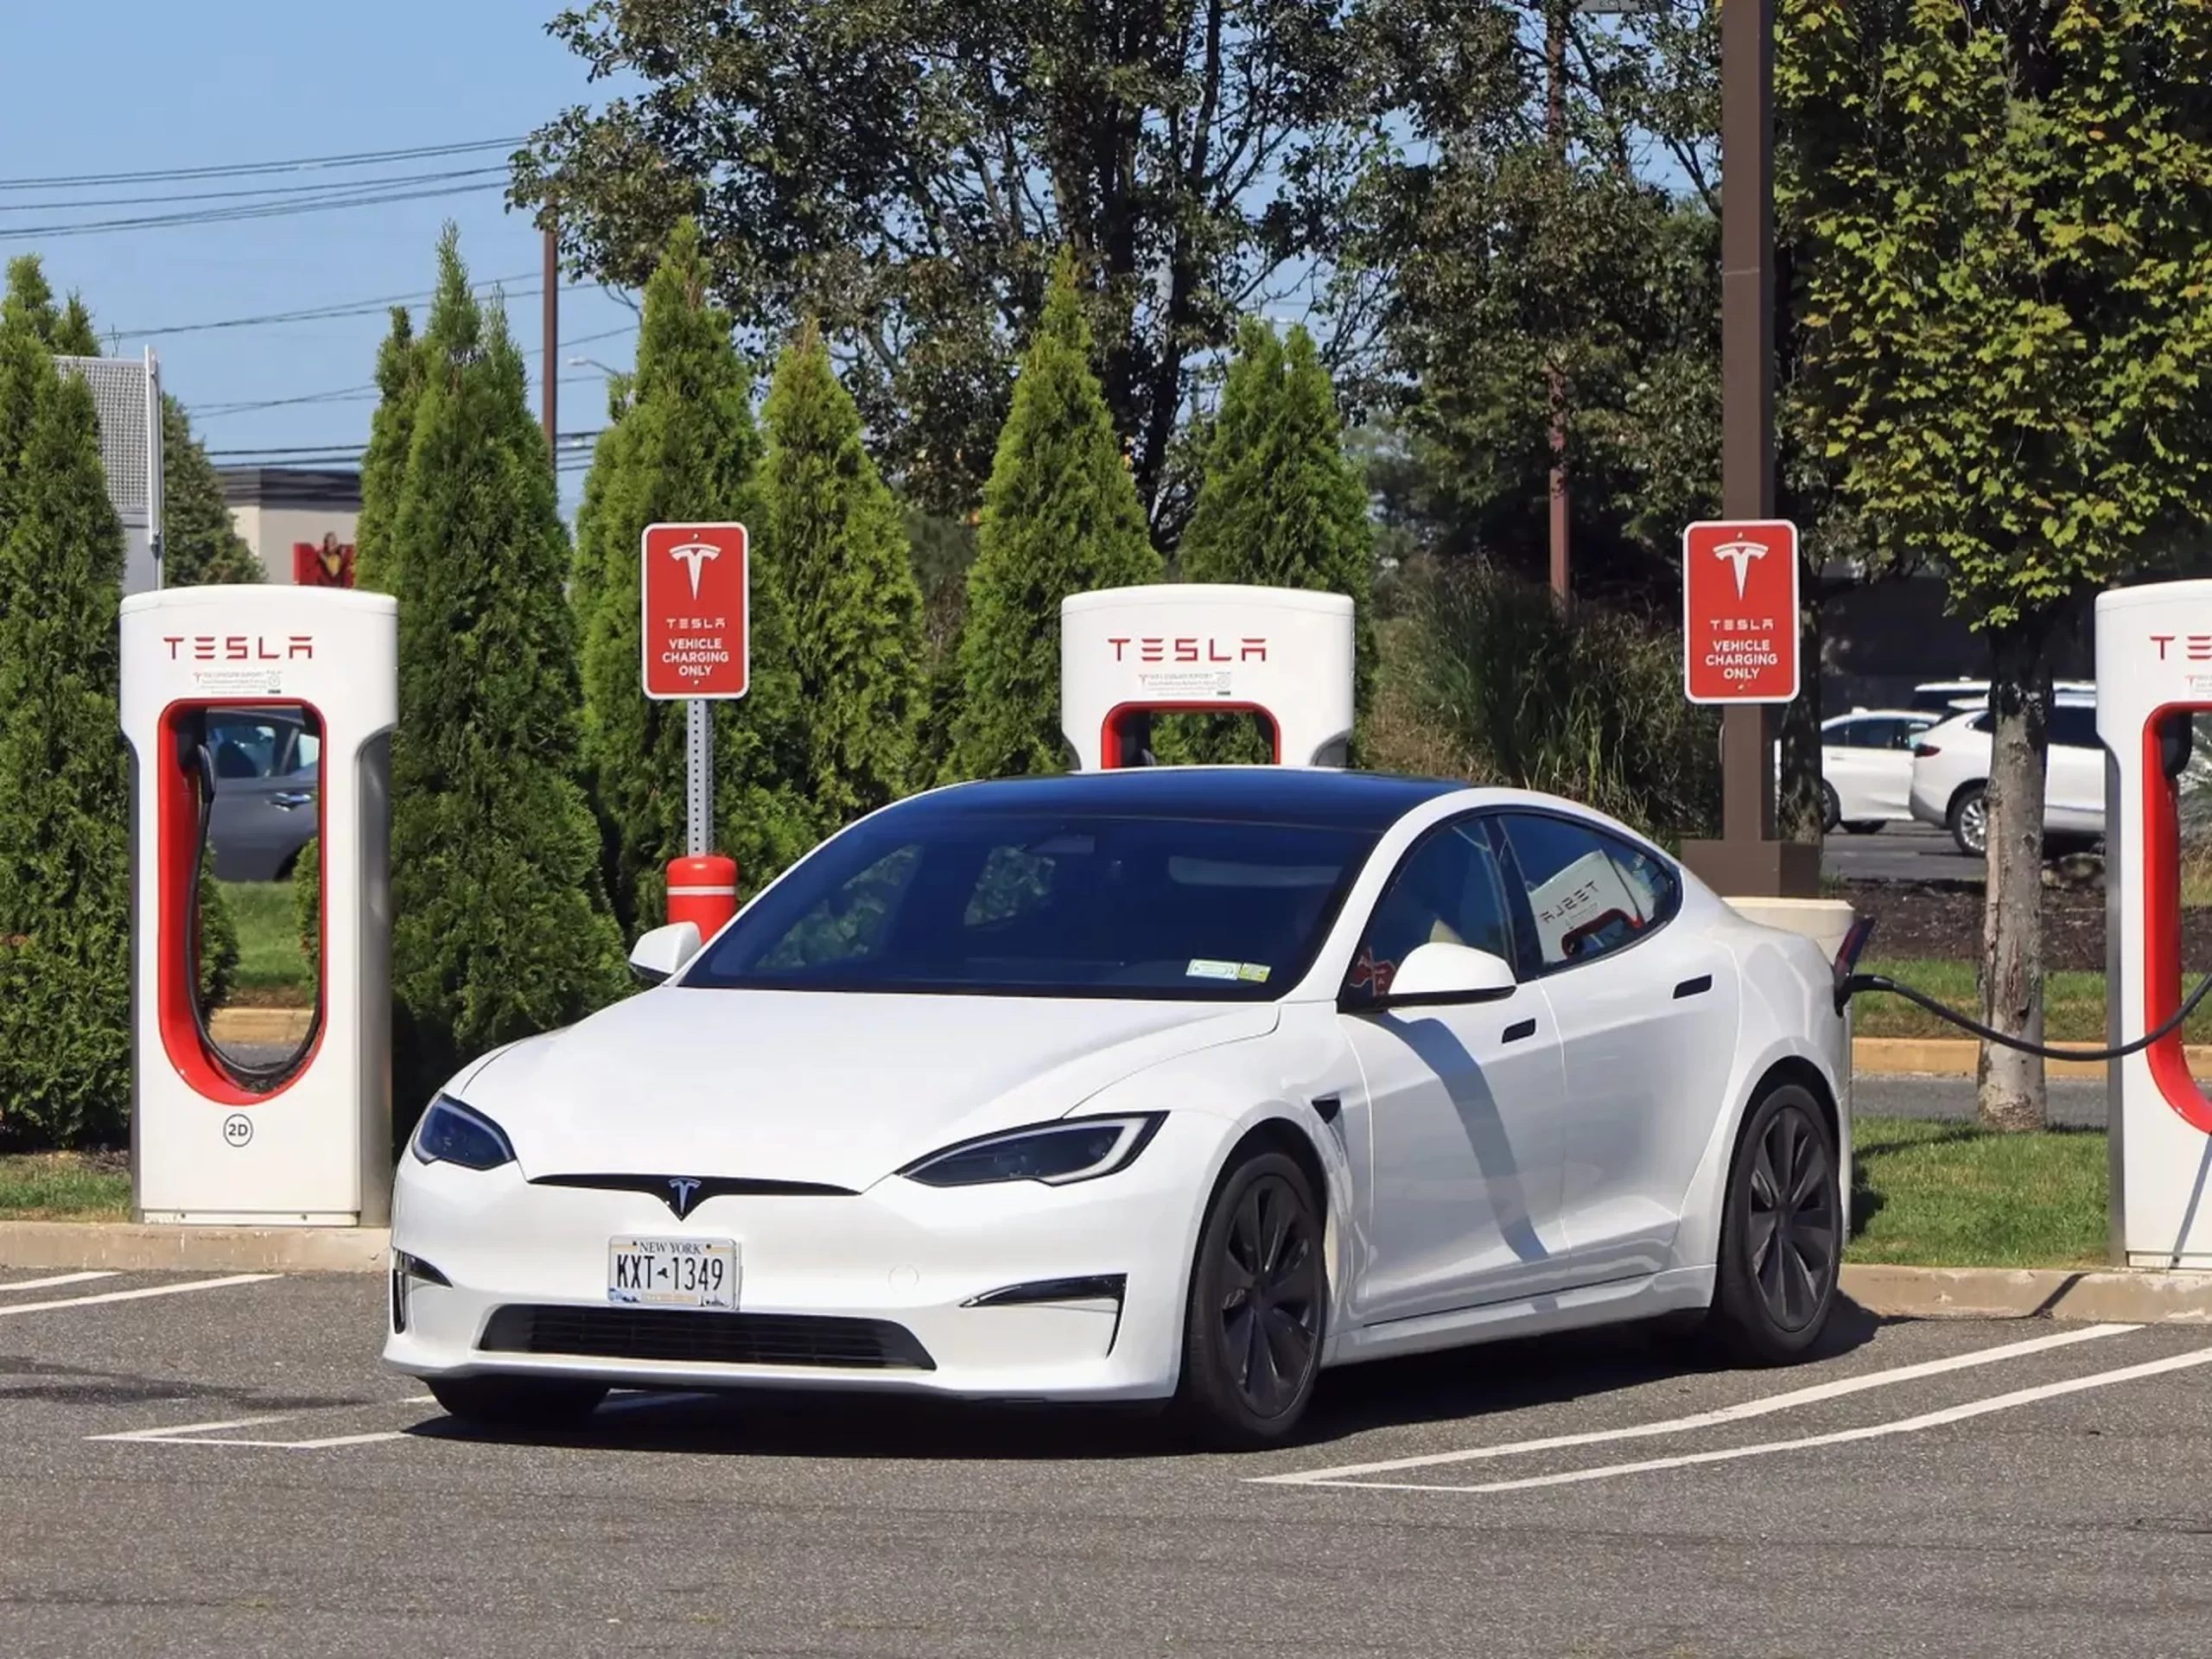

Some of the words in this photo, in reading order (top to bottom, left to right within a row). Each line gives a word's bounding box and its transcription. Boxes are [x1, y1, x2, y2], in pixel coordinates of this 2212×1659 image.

[666, 618, 726, 630] TESLA
[1710, 619, 1774, 631] TESLA
[163, 636, 313, 659] TESLA
[669, 638, 722, 650] VEHICLE
[1108, 638, 1267, 662] TESLA
[1713, 639, 1770, 652] VEHICLE
[662, 651, 729, 663] CHARGING
[1706, 653, 1778, 666] CHARGING
[678, 664, 713, 677] ONLY
[1723, 667, 1760, 680] ONLY
[228, 1123, 248, 1136] 2D
[639, 1242, 667, 1253] NEW
[670, 1243, 702, 1255] YORK
[617, 1255, 655, 1288] KXT
[672, 1256, 723, 1292] 1349
